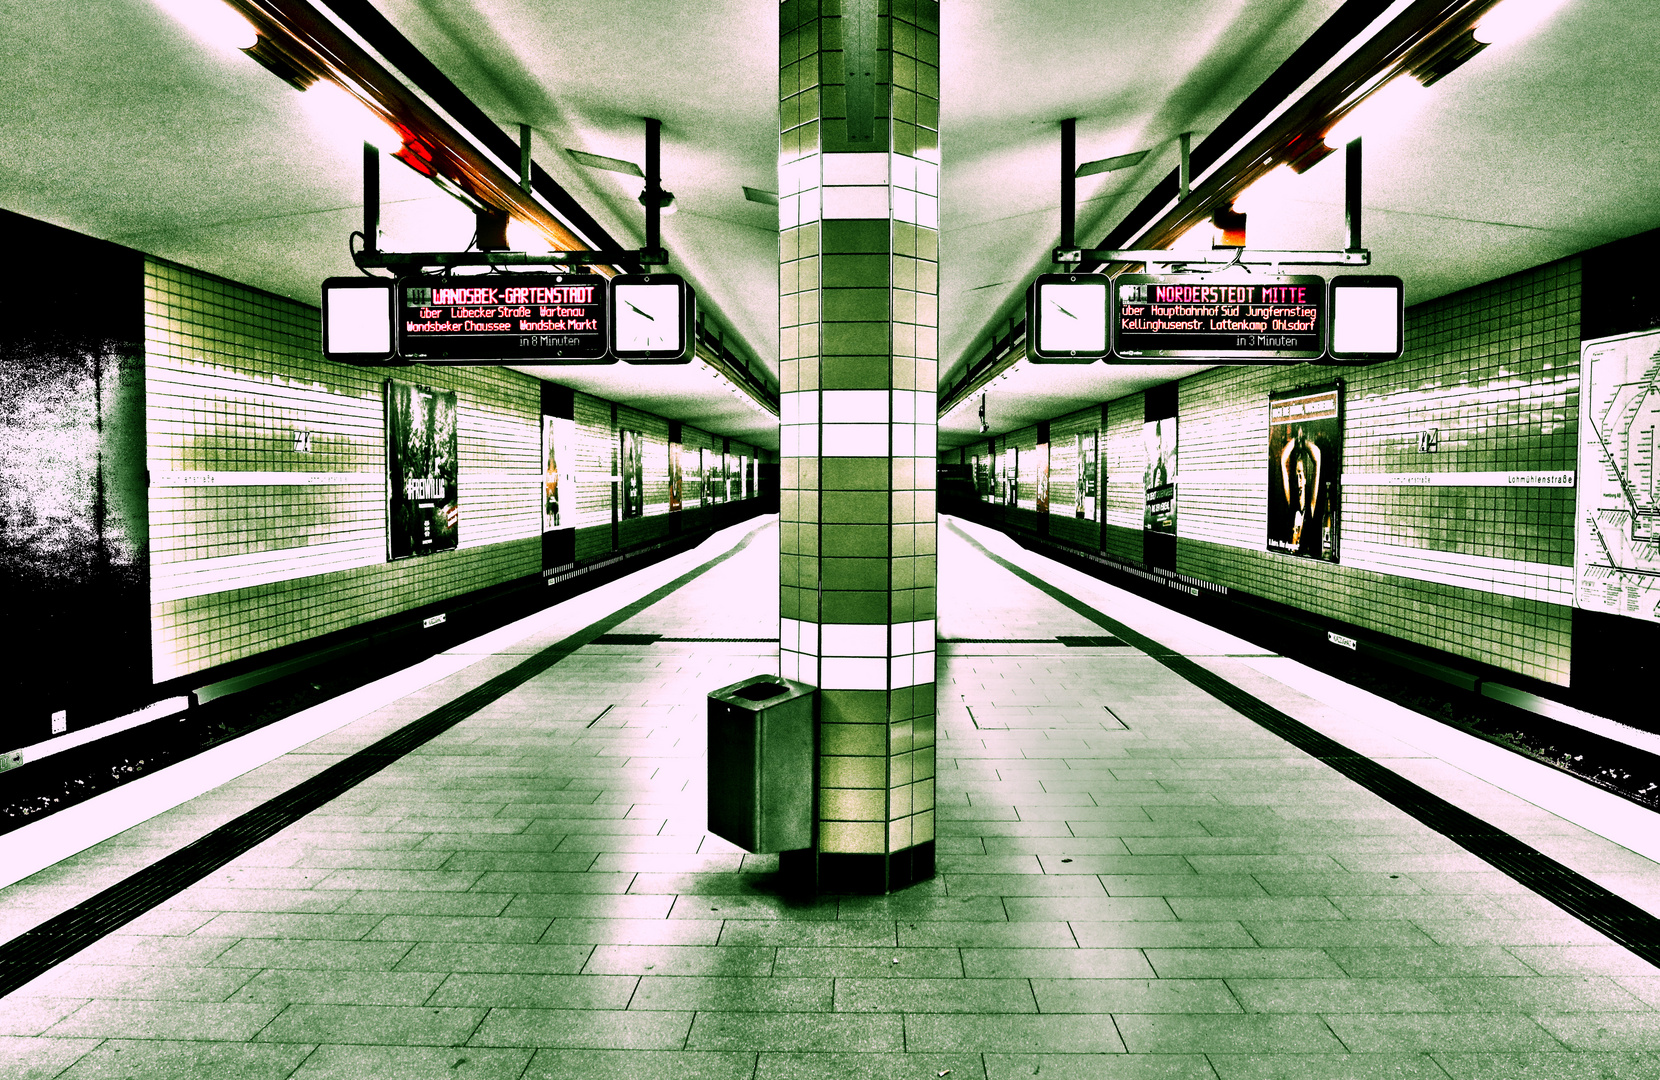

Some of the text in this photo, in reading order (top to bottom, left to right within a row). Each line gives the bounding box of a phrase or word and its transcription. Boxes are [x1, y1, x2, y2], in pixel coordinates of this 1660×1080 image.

[412, 286, 595, 305] U1 WANDSBEK-GARTENSTADT
[1156, 286, 1255, 303] NORDERSTEDT
[1262, 286, 1307, 303] MITTE
[419, 305, 585, 319] über Lübecker Straße Wartenau
[1122, 305, 1317, 320] über Hauptbahnhof Süd Jungfernstieg
[406, 319, 597, 332] Wandsbeker Chaussee Wandsbek Markt
[1122, 318, 1315, 332] Kellinghusenstr. Lattenkamp Ohlsdorf
[519, 335, 580, 347] in 8 Minuten
[1236, 335, 1298, 346] in 3 Minuten
[1508, 474, 1573, 484] Lohmühlenstraße
